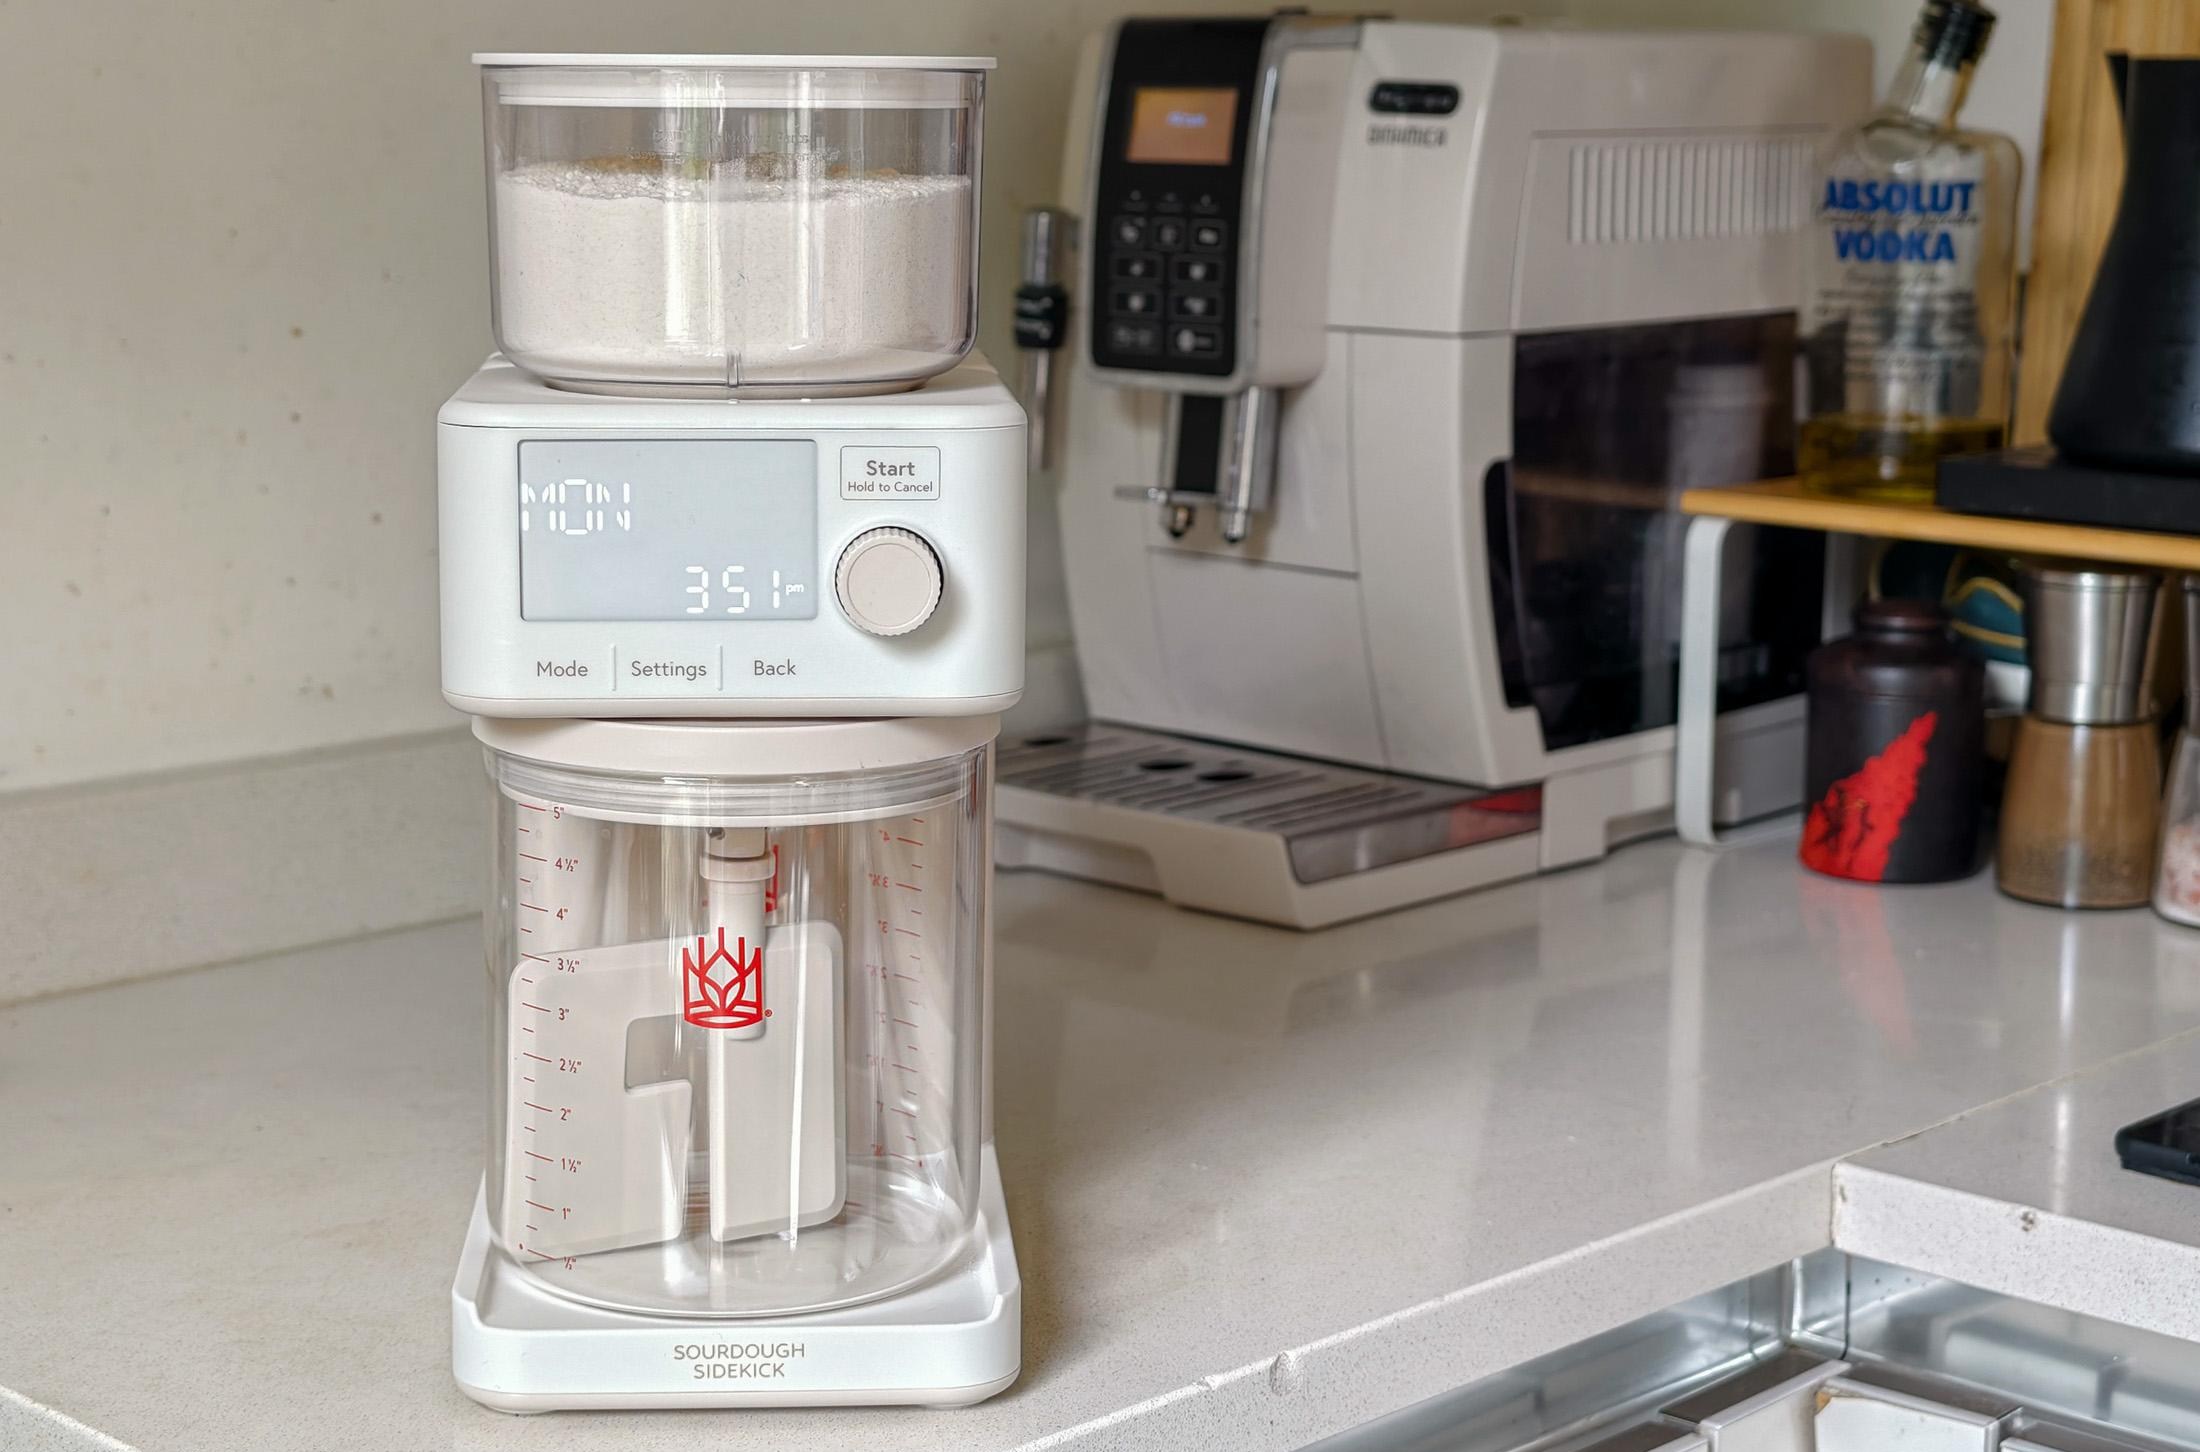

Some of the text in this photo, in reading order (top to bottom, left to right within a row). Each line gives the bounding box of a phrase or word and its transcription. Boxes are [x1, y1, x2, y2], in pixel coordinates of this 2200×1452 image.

[1822, 178, 1975, 214] ABSOLUT
[1834, 229, 1956, 265] VODKA
[866, 459, 915, 476] Start
[847, 480, 932, 492] Hold to Cancel
[521, 478, 631, 535] MON
[785, 583, 805, 596] pm
[536, 660, 588, 677] Mode
[631, 660, 707, 681] Settings
[754, 659, 796, 676] Back
[553, 806, 565, 820] 5"
[556, 908, 568, 921] 4"
[558, 1008, 570, 1021] 3"
[560, 1108, 572, 1121] 2"
[562, 1207, 572, 1220] 1"
[673, 1343, 805, 1360] SOURDOUGH
[693, 1363, 785, 1379] SIDEKICK
